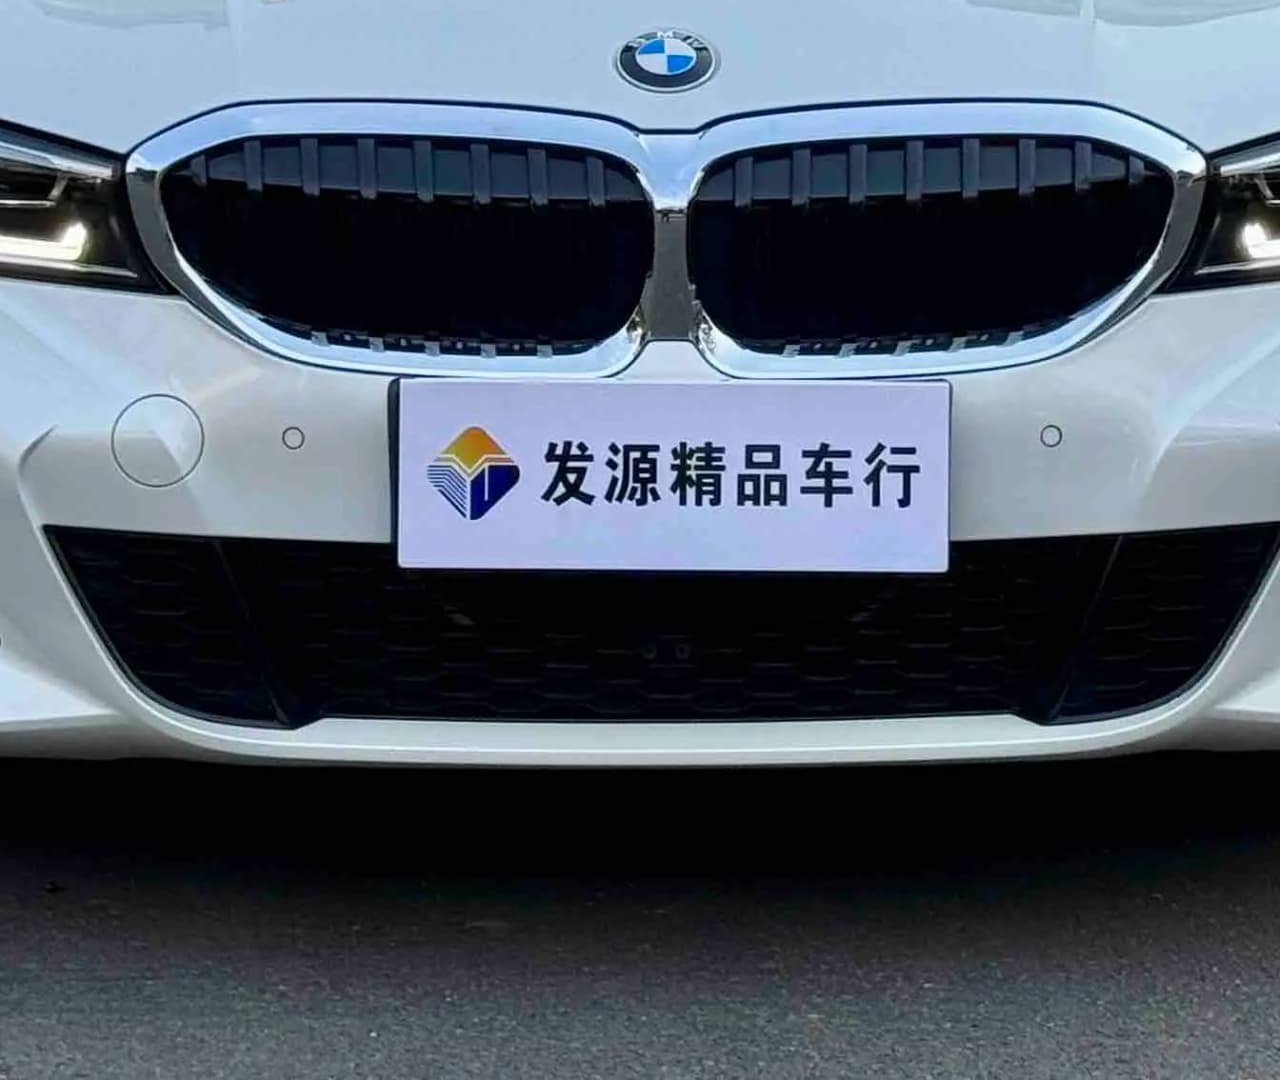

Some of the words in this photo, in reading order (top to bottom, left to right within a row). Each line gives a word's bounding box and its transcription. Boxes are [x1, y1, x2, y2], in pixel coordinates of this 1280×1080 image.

[540, 440, 921, 508] 发源精品车行
